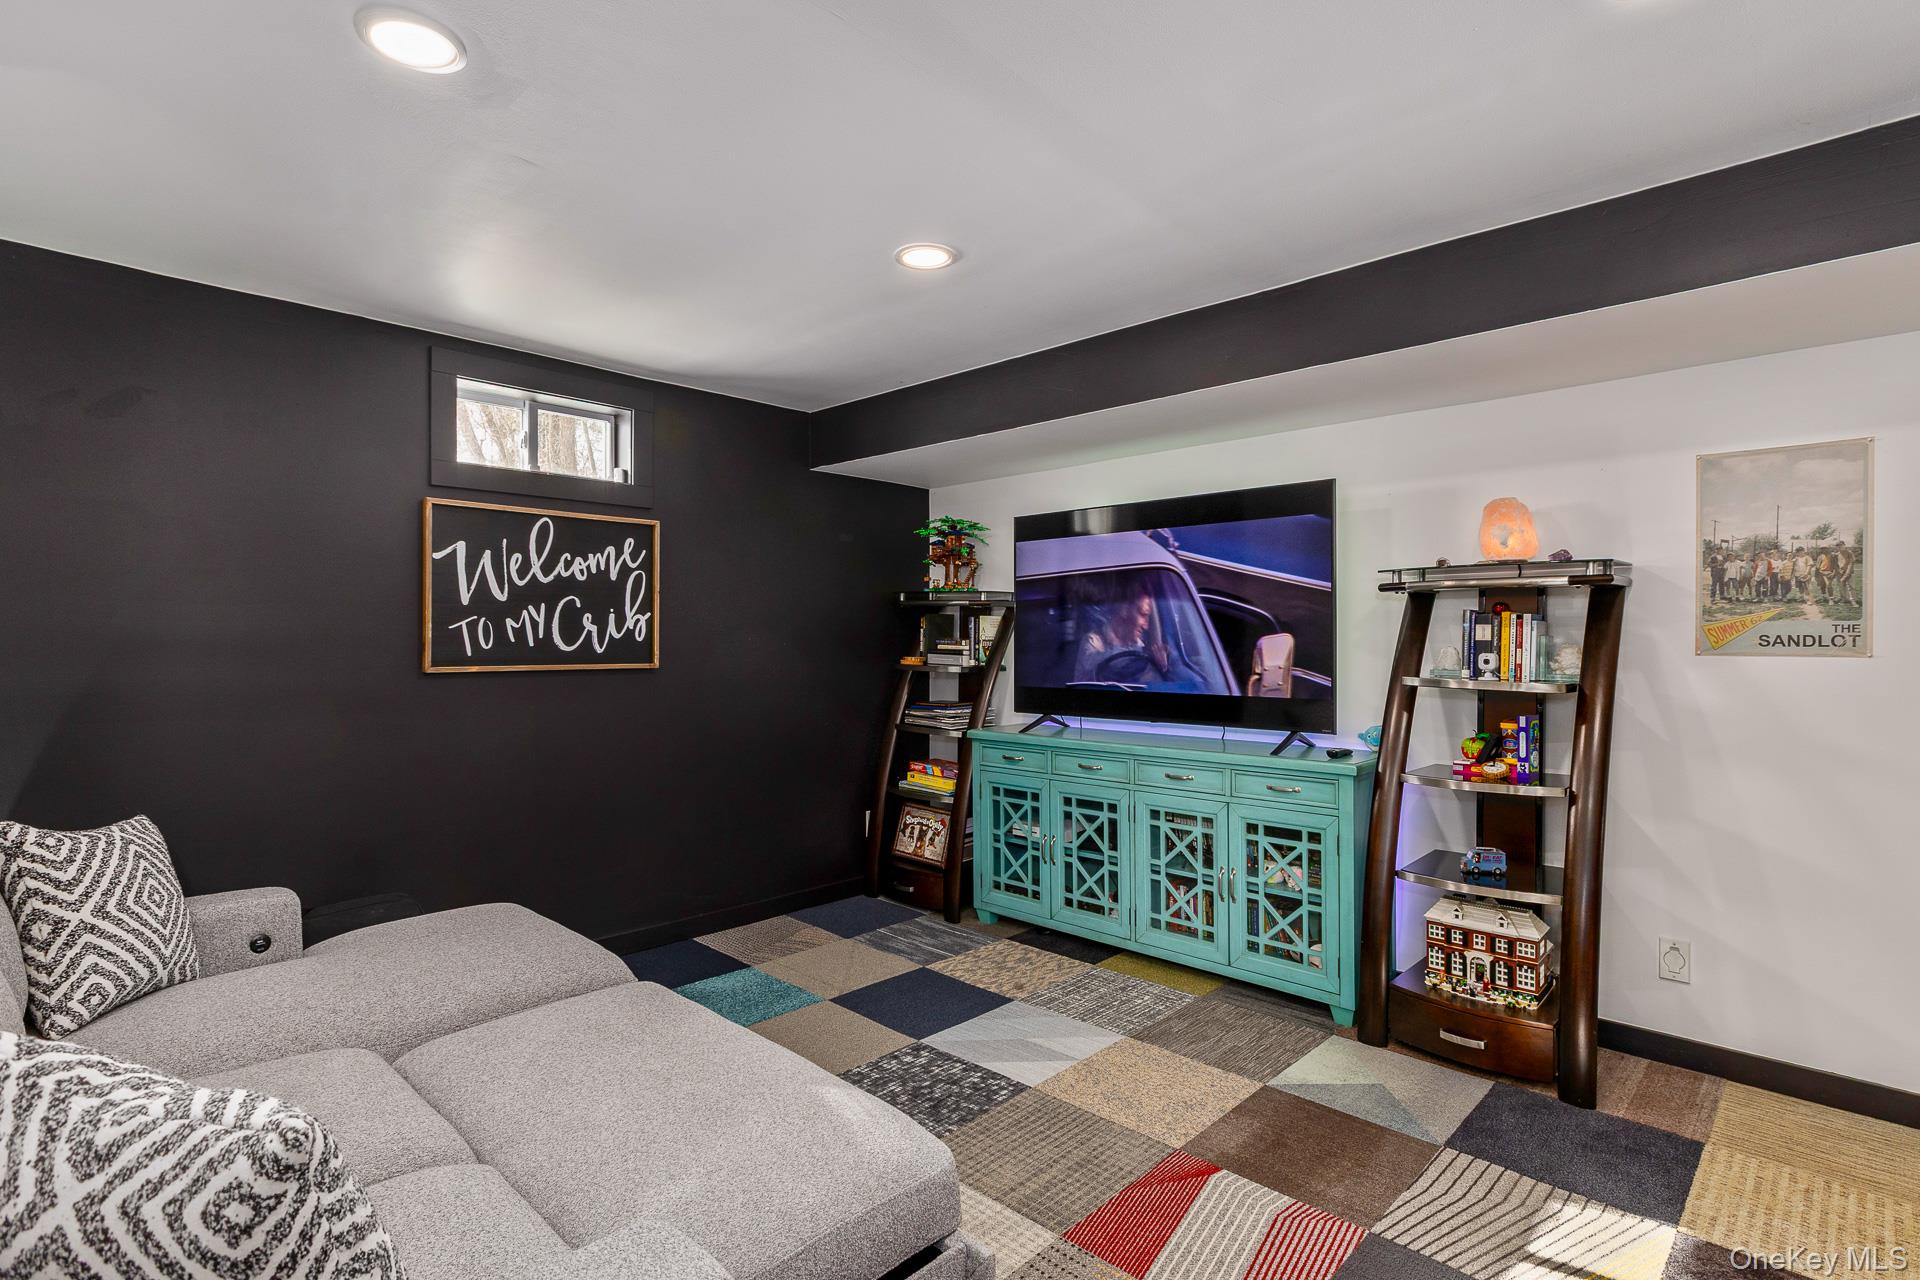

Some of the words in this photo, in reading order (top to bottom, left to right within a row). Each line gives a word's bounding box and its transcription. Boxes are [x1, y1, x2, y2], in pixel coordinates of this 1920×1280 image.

[432, 517, 646, 606] Welcome
[448, 615, 494, 657] TO
[505, 602, 546, 647] MY
[552, 570, 651, 653] Crib
[1707, 619, 1749, 644] SUMMER
[1758, 634, 1862, 648] SANDLOT
[1831, 623, 1862, 634] THE
